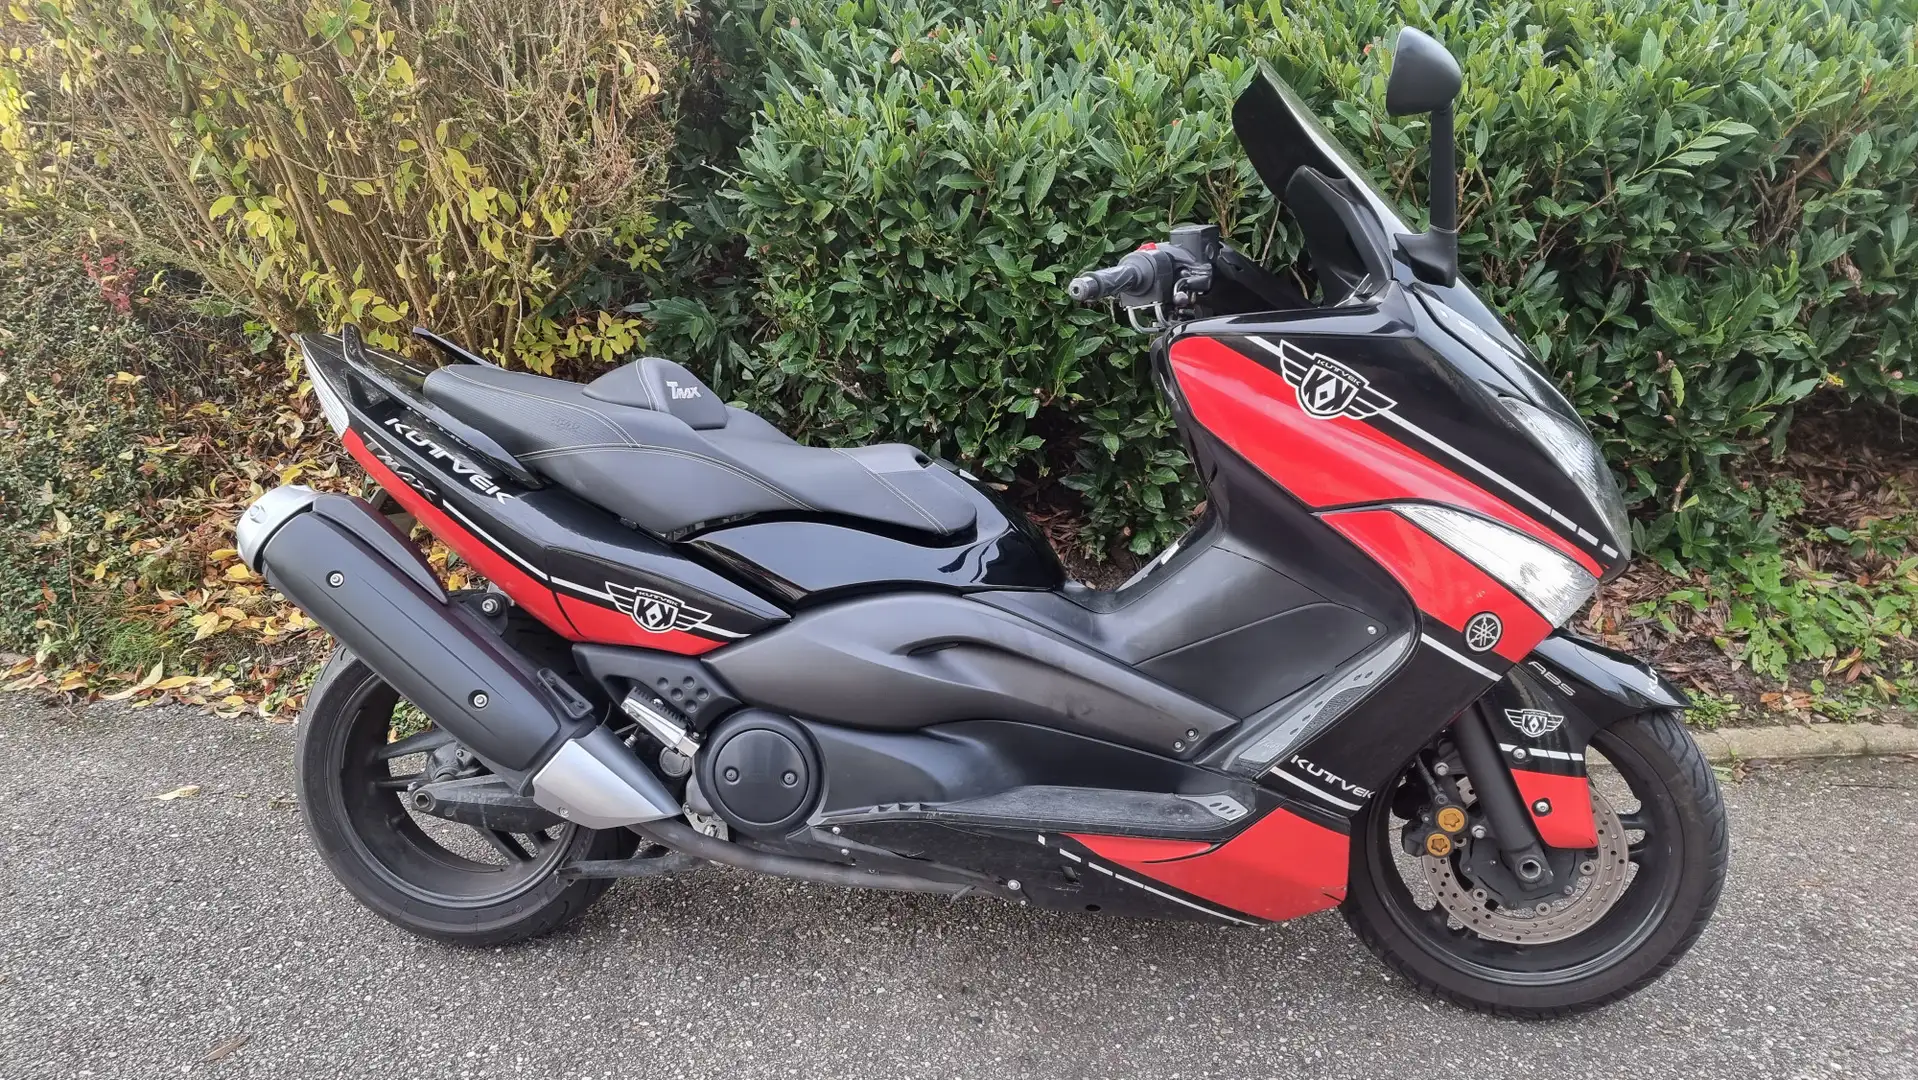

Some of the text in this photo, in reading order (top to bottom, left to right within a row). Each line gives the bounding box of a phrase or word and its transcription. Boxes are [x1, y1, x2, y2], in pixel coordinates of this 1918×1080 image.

[1317, 359, 1362, 386] KUTVEK
[384, 418, 516, 505] KUTVEK
[638, 590, 679, 607] KUTVEK
[1528, 660, 1576, 697] ABS
[1290, 754, 1376, 799] KUTVEK
